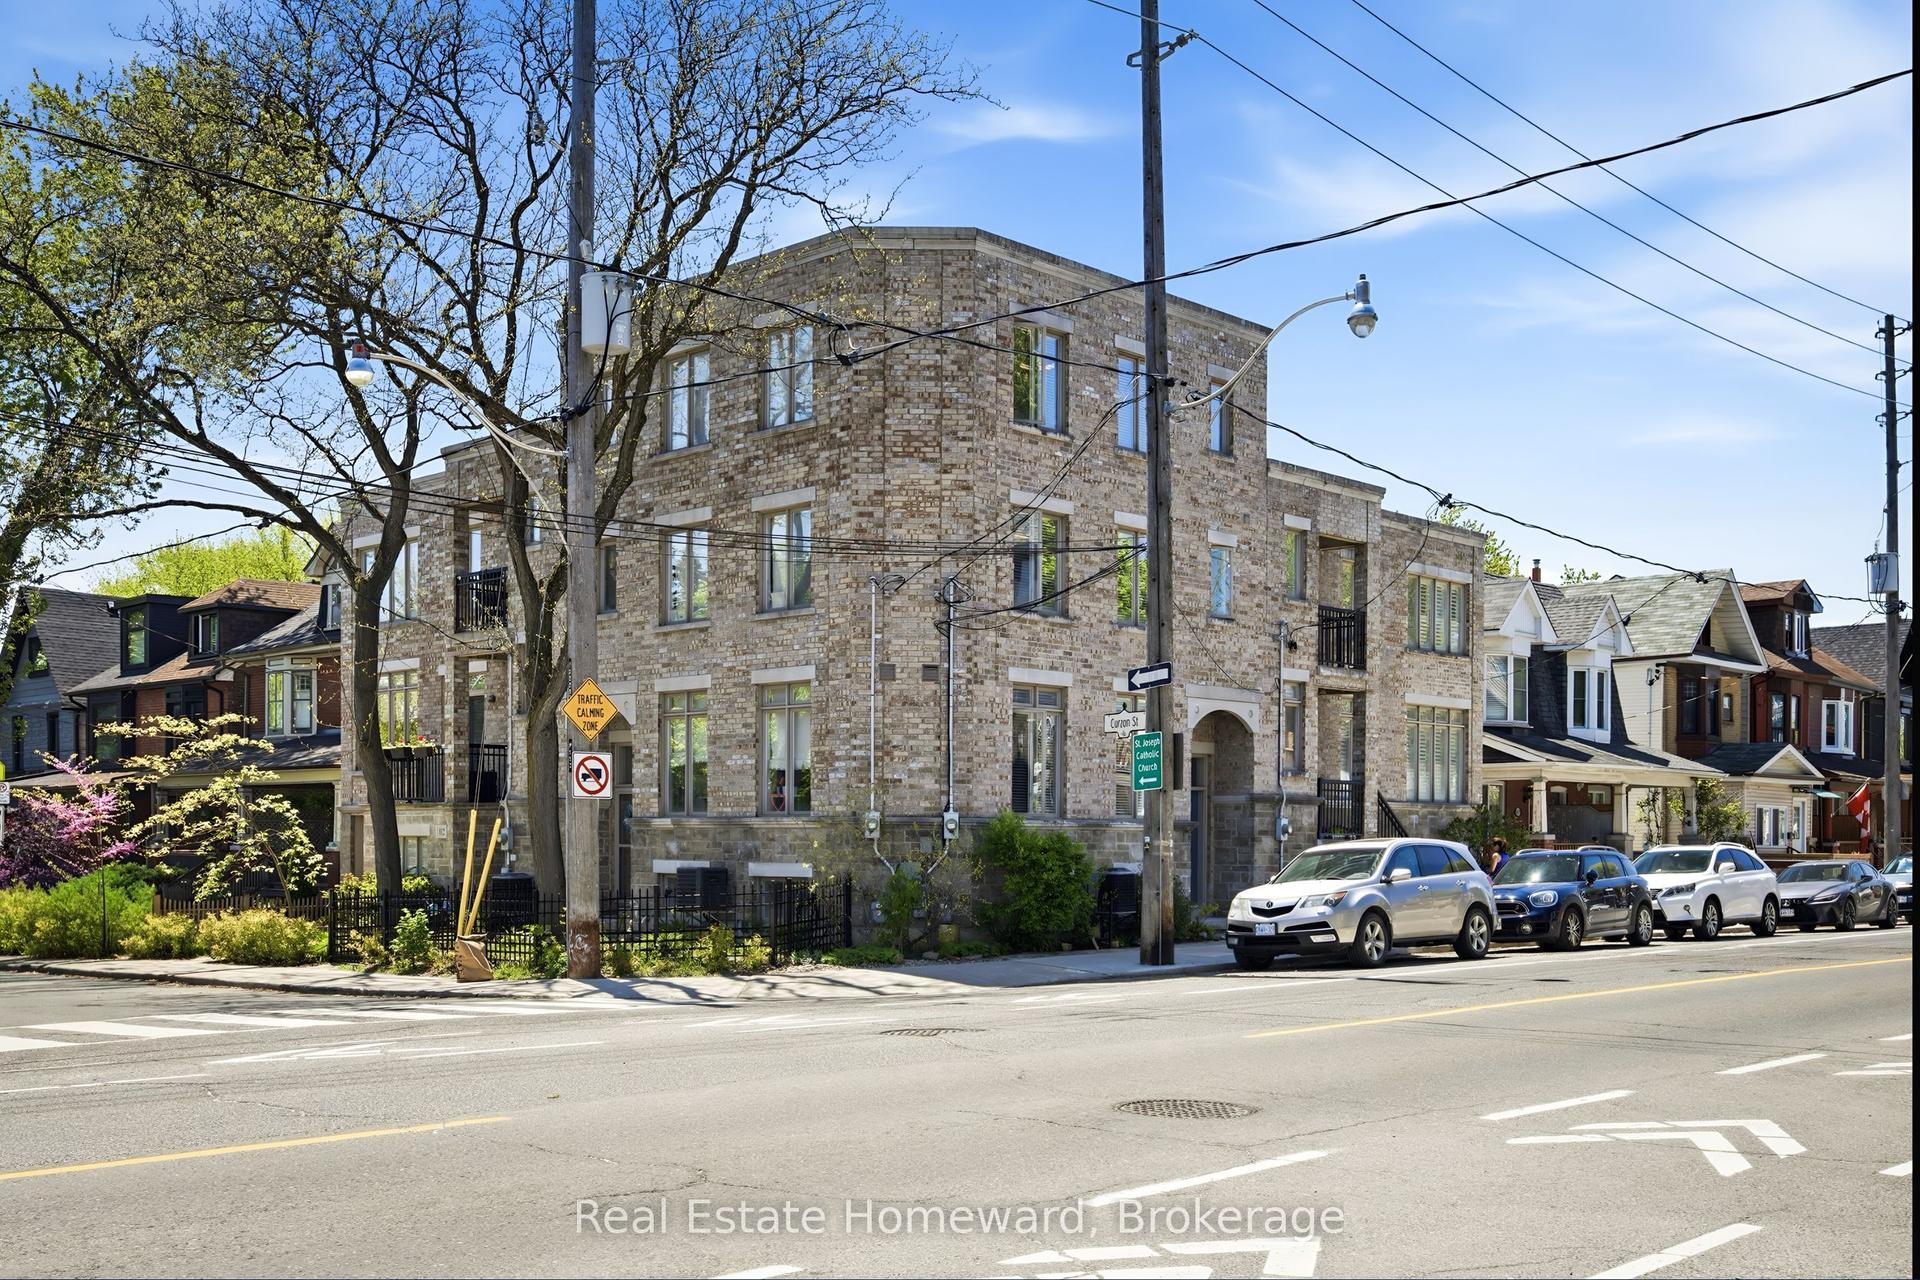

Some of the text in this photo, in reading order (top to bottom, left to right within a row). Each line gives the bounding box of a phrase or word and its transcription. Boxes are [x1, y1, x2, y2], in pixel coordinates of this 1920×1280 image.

[577, 694, 603, 704] TRAFFIC
[576, 708, 604, 718] CALMING
[582, 721, 599, 731] ZONE
[1110, 715, 1139, 729] Curzon St
[1142, 737, 1161, 748] Joseph
[1136, 749, 1159, 760] Catholic
[1138, 763, 1158, 772] Church
